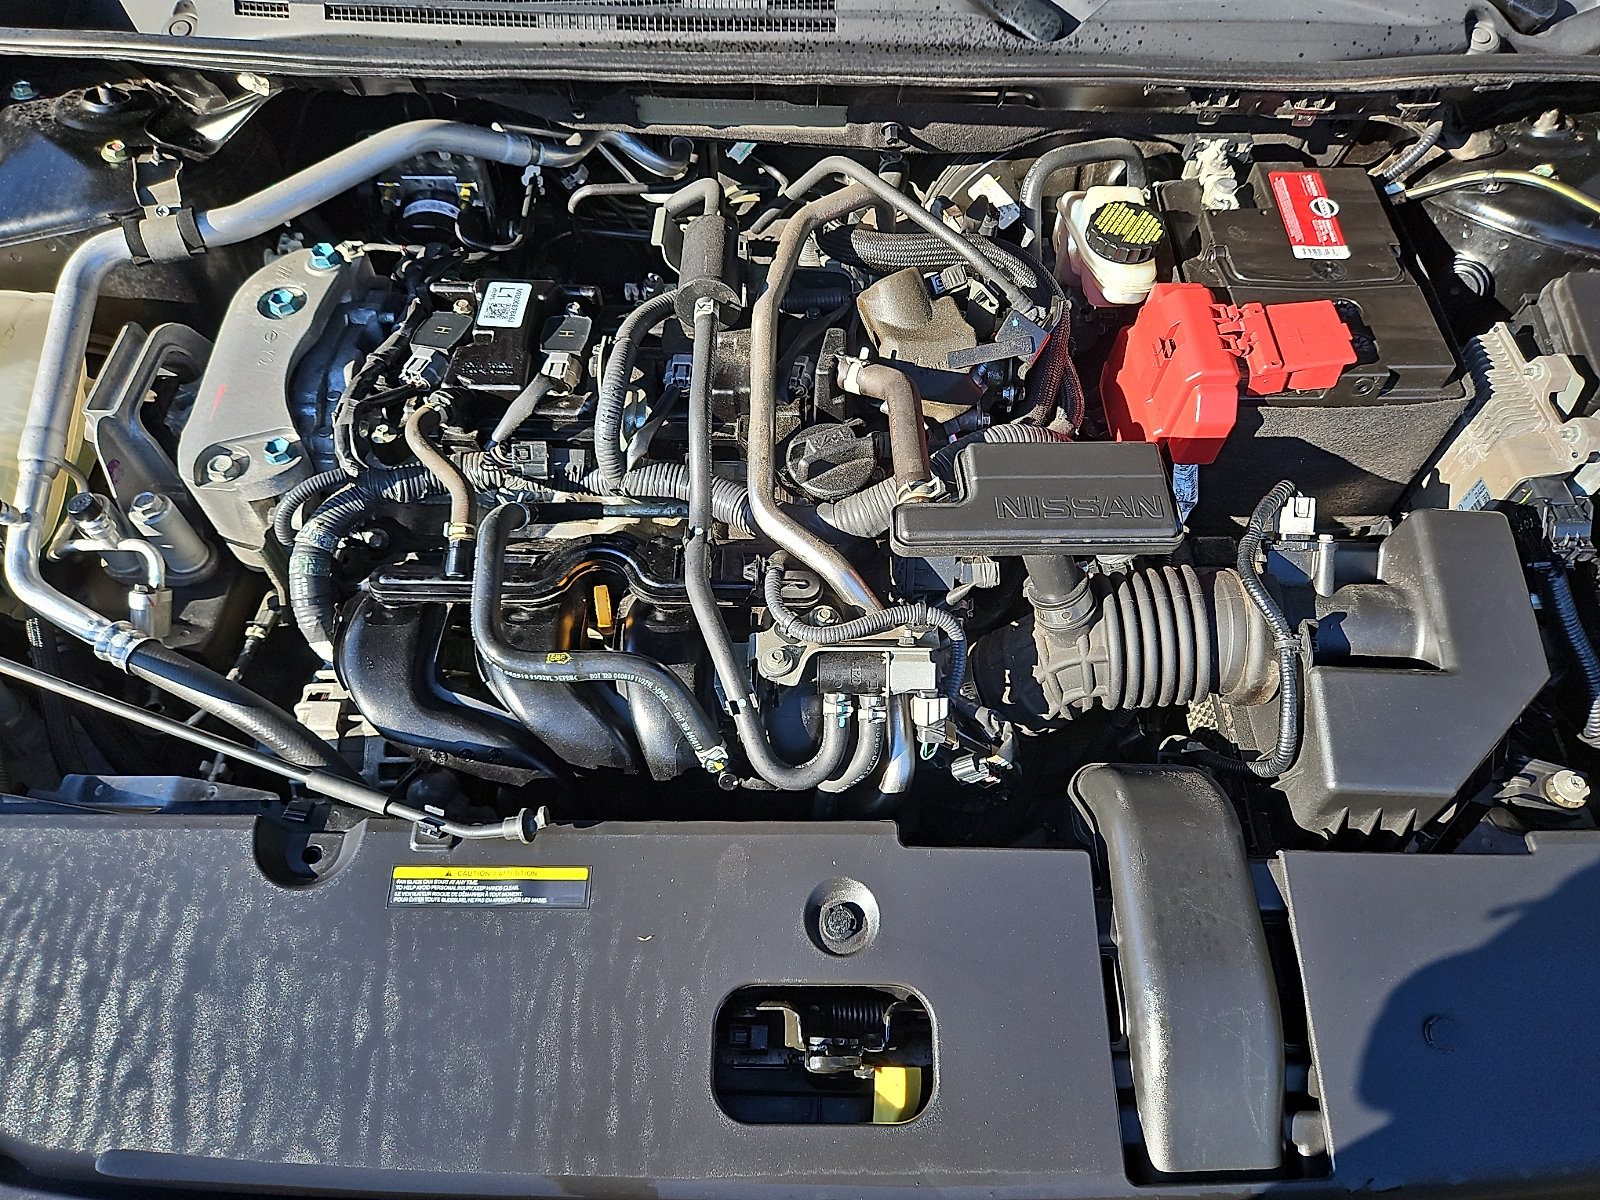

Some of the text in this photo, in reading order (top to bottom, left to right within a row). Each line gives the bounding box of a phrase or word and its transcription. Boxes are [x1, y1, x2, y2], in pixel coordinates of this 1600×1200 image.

[497, 287, 516, 298] L1
[994, 494, 1165, 519] NISSAN
[457, 869, 490, 877] CAUTION
[498, 869, 538, 877] ATTENTION
